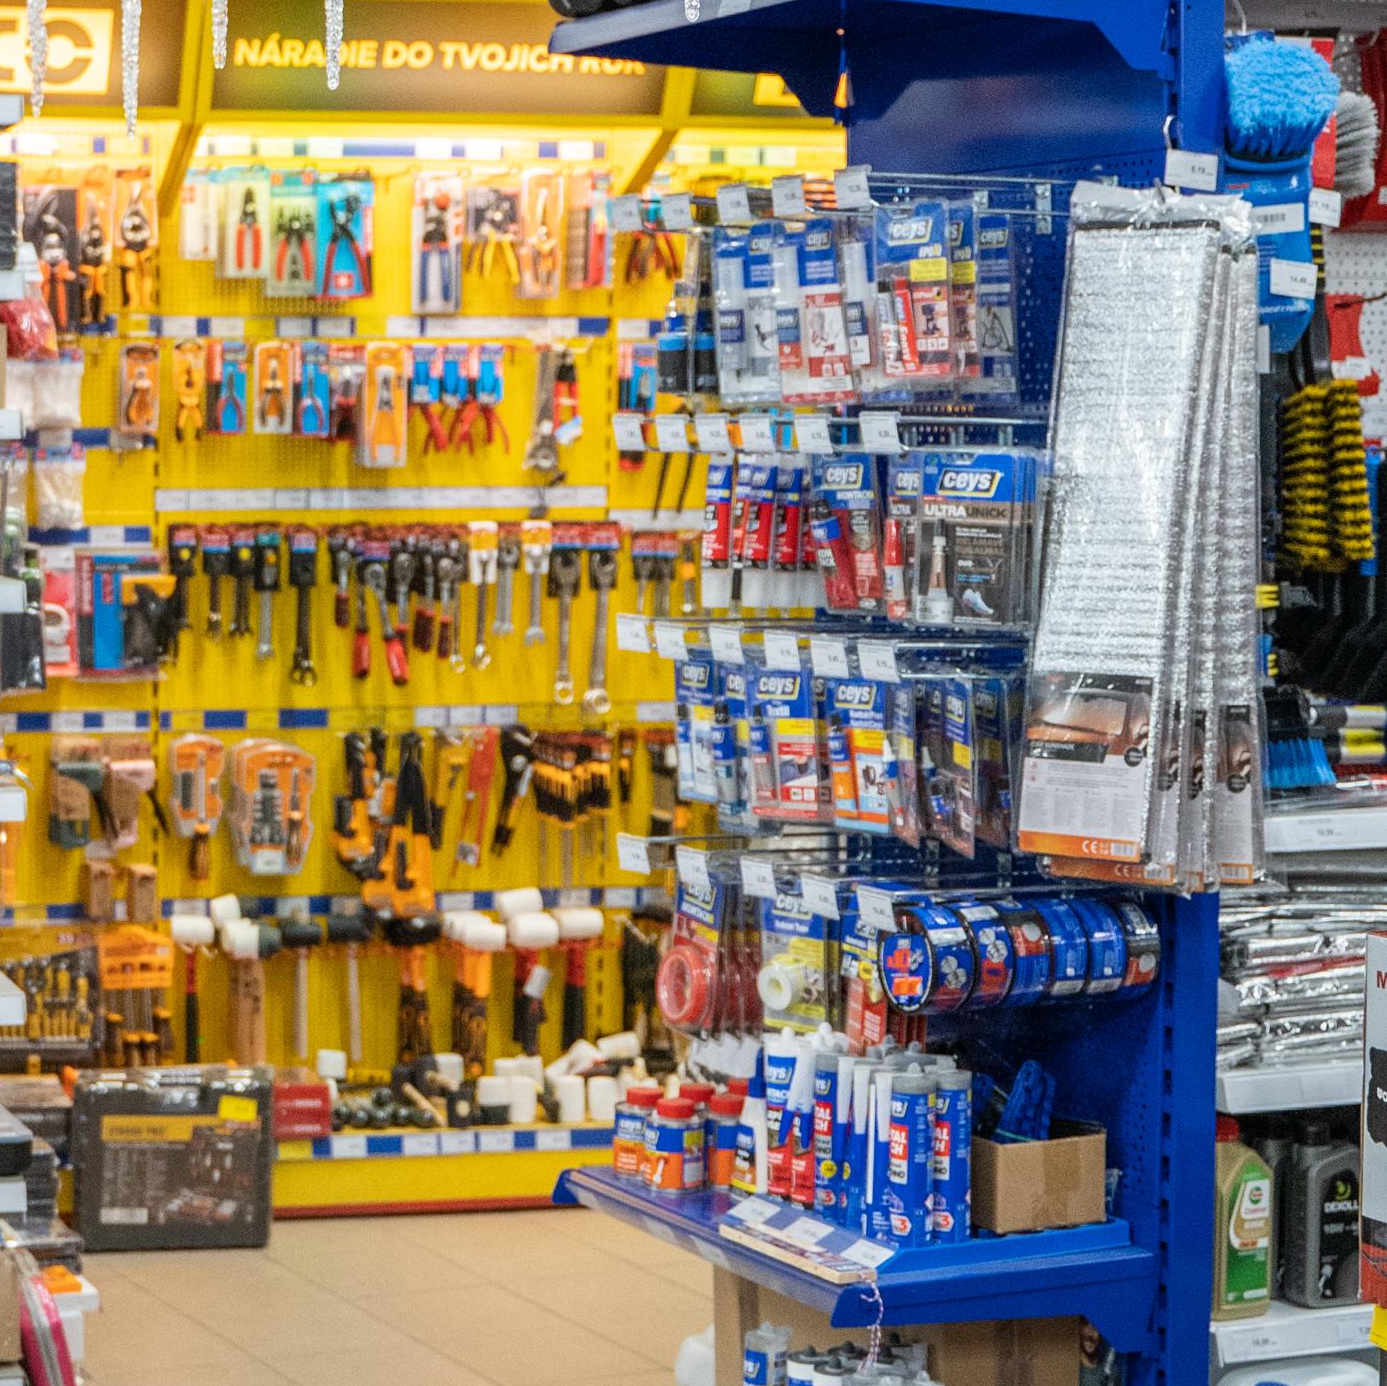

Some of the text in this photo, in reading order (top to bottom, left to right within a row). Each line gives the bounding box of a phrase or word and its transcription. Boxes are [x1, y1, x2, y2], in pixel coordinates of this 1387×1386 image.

[382, 40, 434, 70] DO
[892, 220, 927, 239] ceys
[826, 466, 858, 484] ceys
[943, 471, 992, 492] ceys
[925, 503, 967, 518] ULTRA
[760, 676, 794, 694] ceys
[838, 684, 869, 702] ceys
